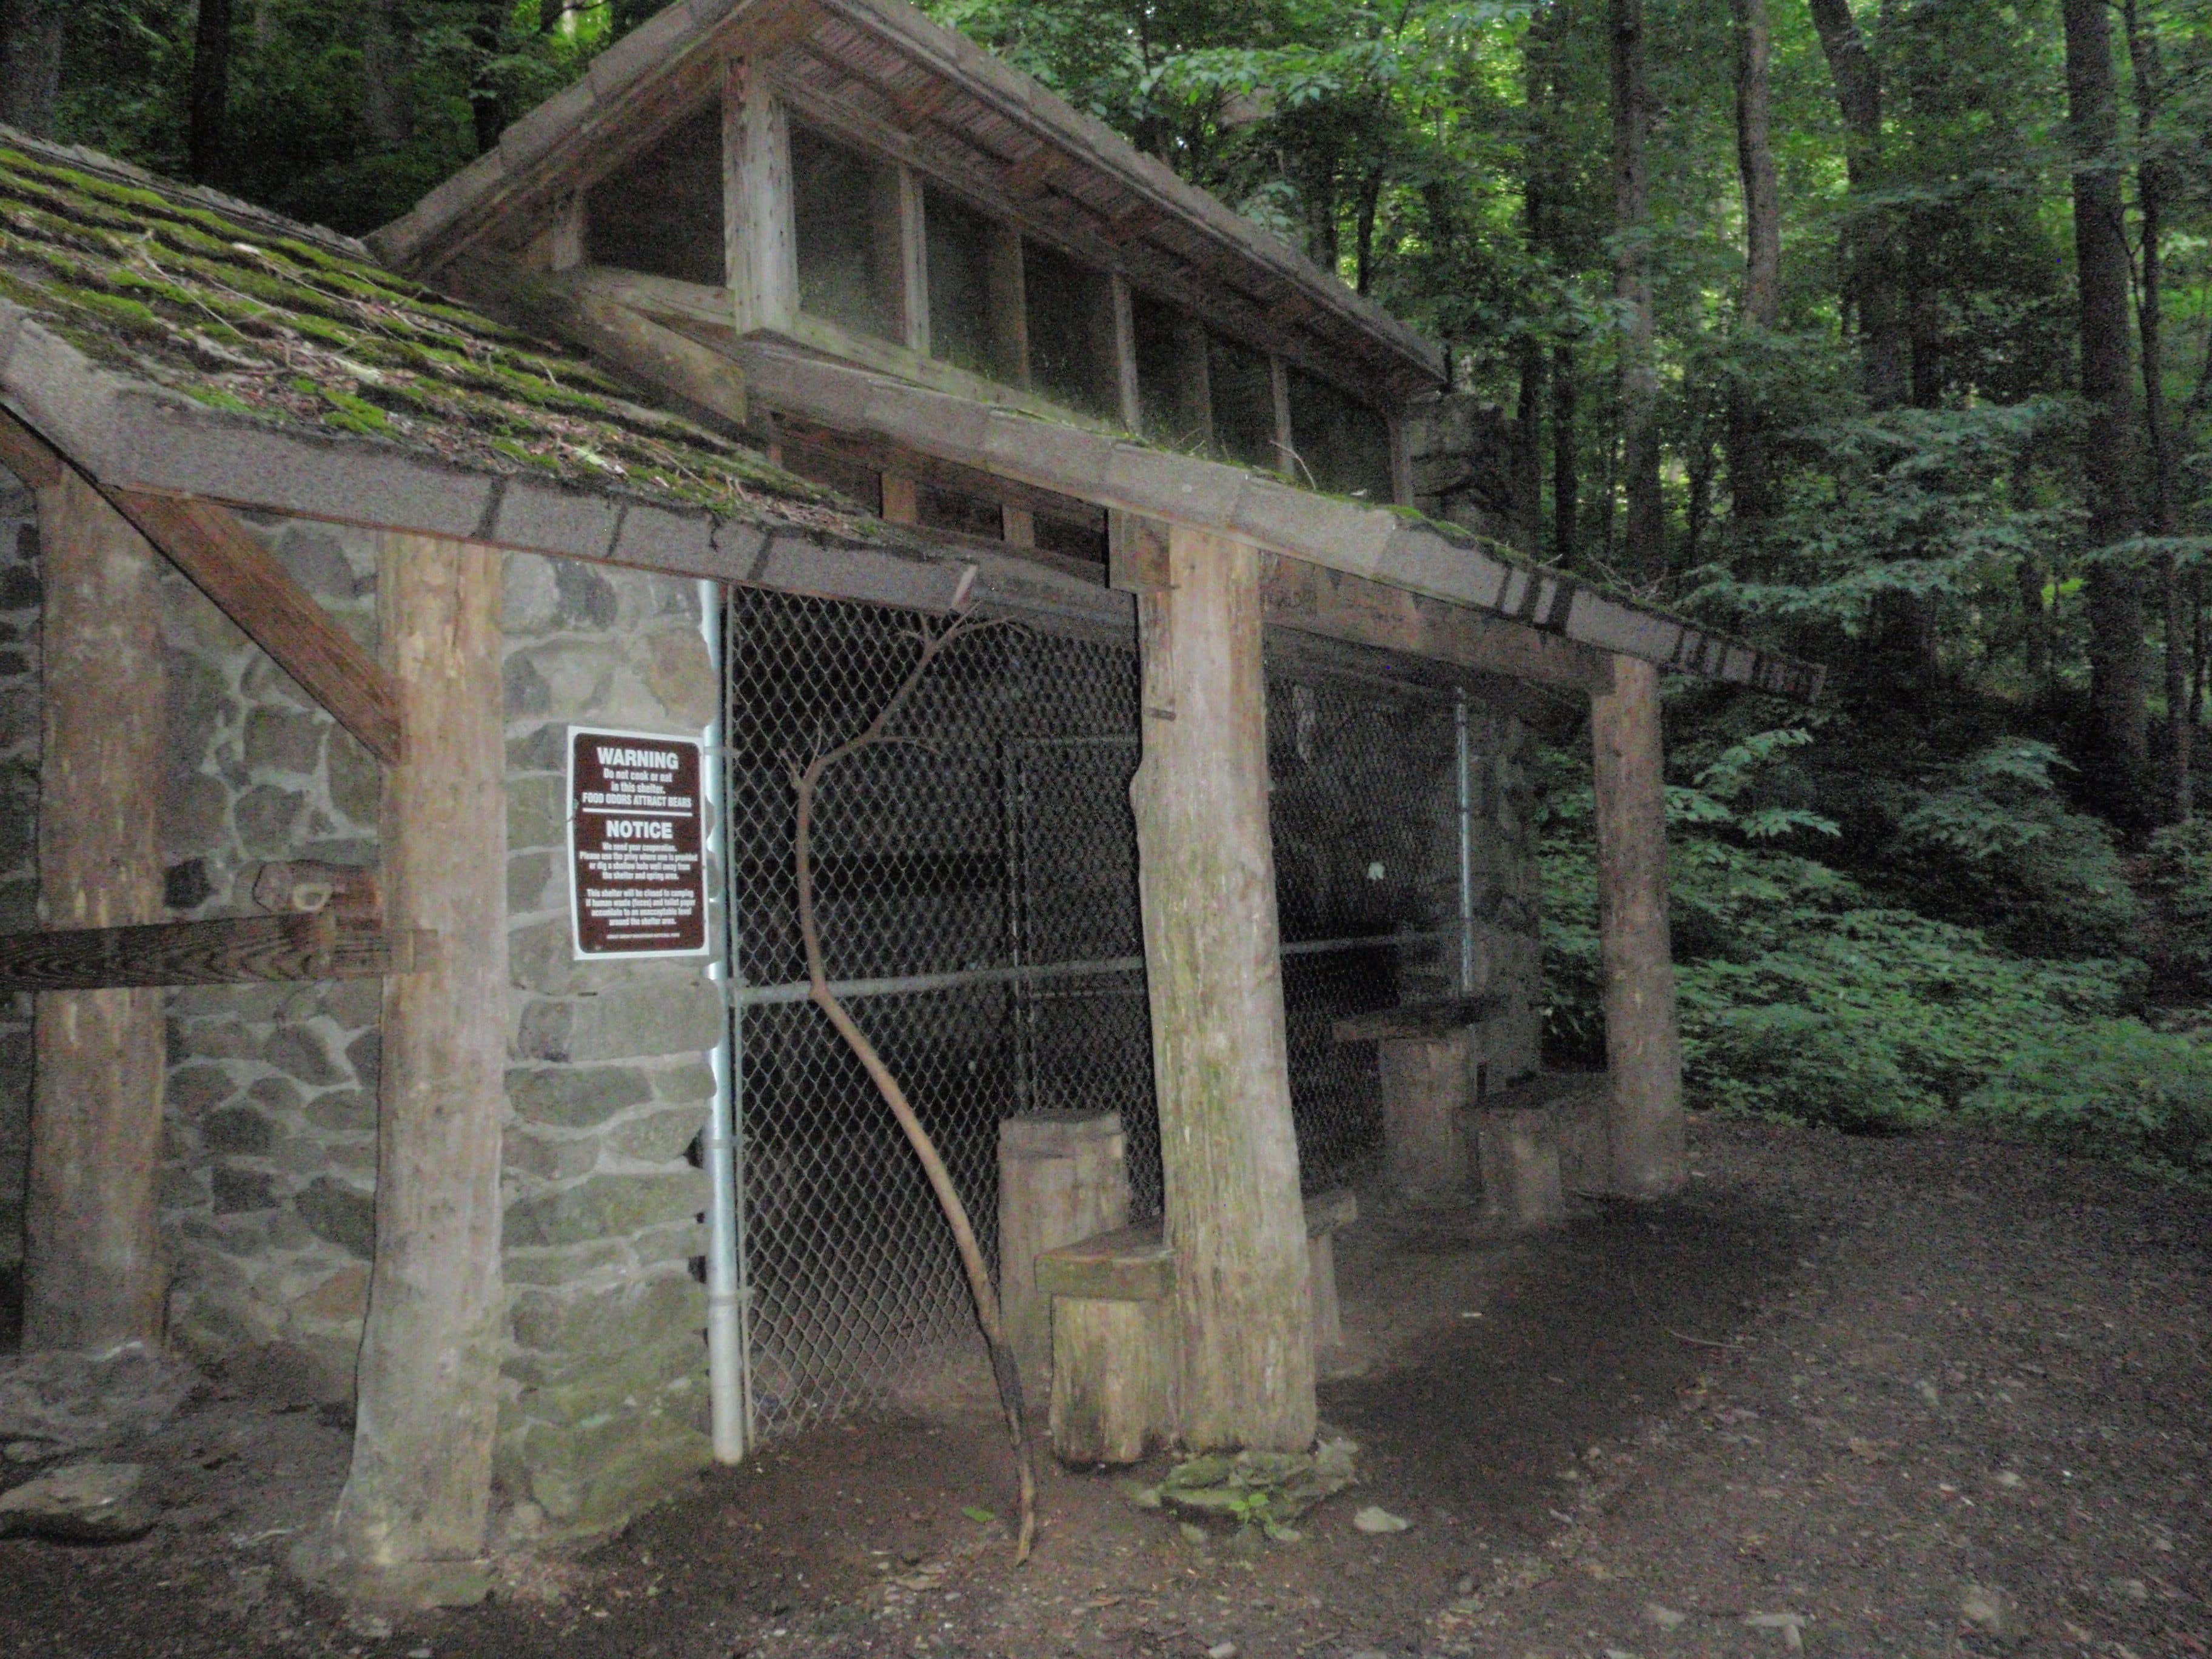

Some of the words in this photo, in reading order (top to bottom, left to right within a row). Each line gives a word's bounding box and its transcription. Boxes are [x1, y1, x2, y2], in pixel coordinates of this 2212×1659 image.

[597, 747, 679, 769] WARNING
[604, 768, 614, 779] Do
[615, 769, 629, 779] not
[631, 770, 648, 780] cook
[660, 773, 672, 782] eat
[620, 782, 635, 793] this
[637, 783, 665, 794] shelter.
[582, 793, 604, 803] FOOD
[606, 794, 632, 805] ODORS
[633, 796, 666, 806] ATTRACT
[668, 797, 692, 808] BEARS
[606, 820, 673, 839] NOTICE
